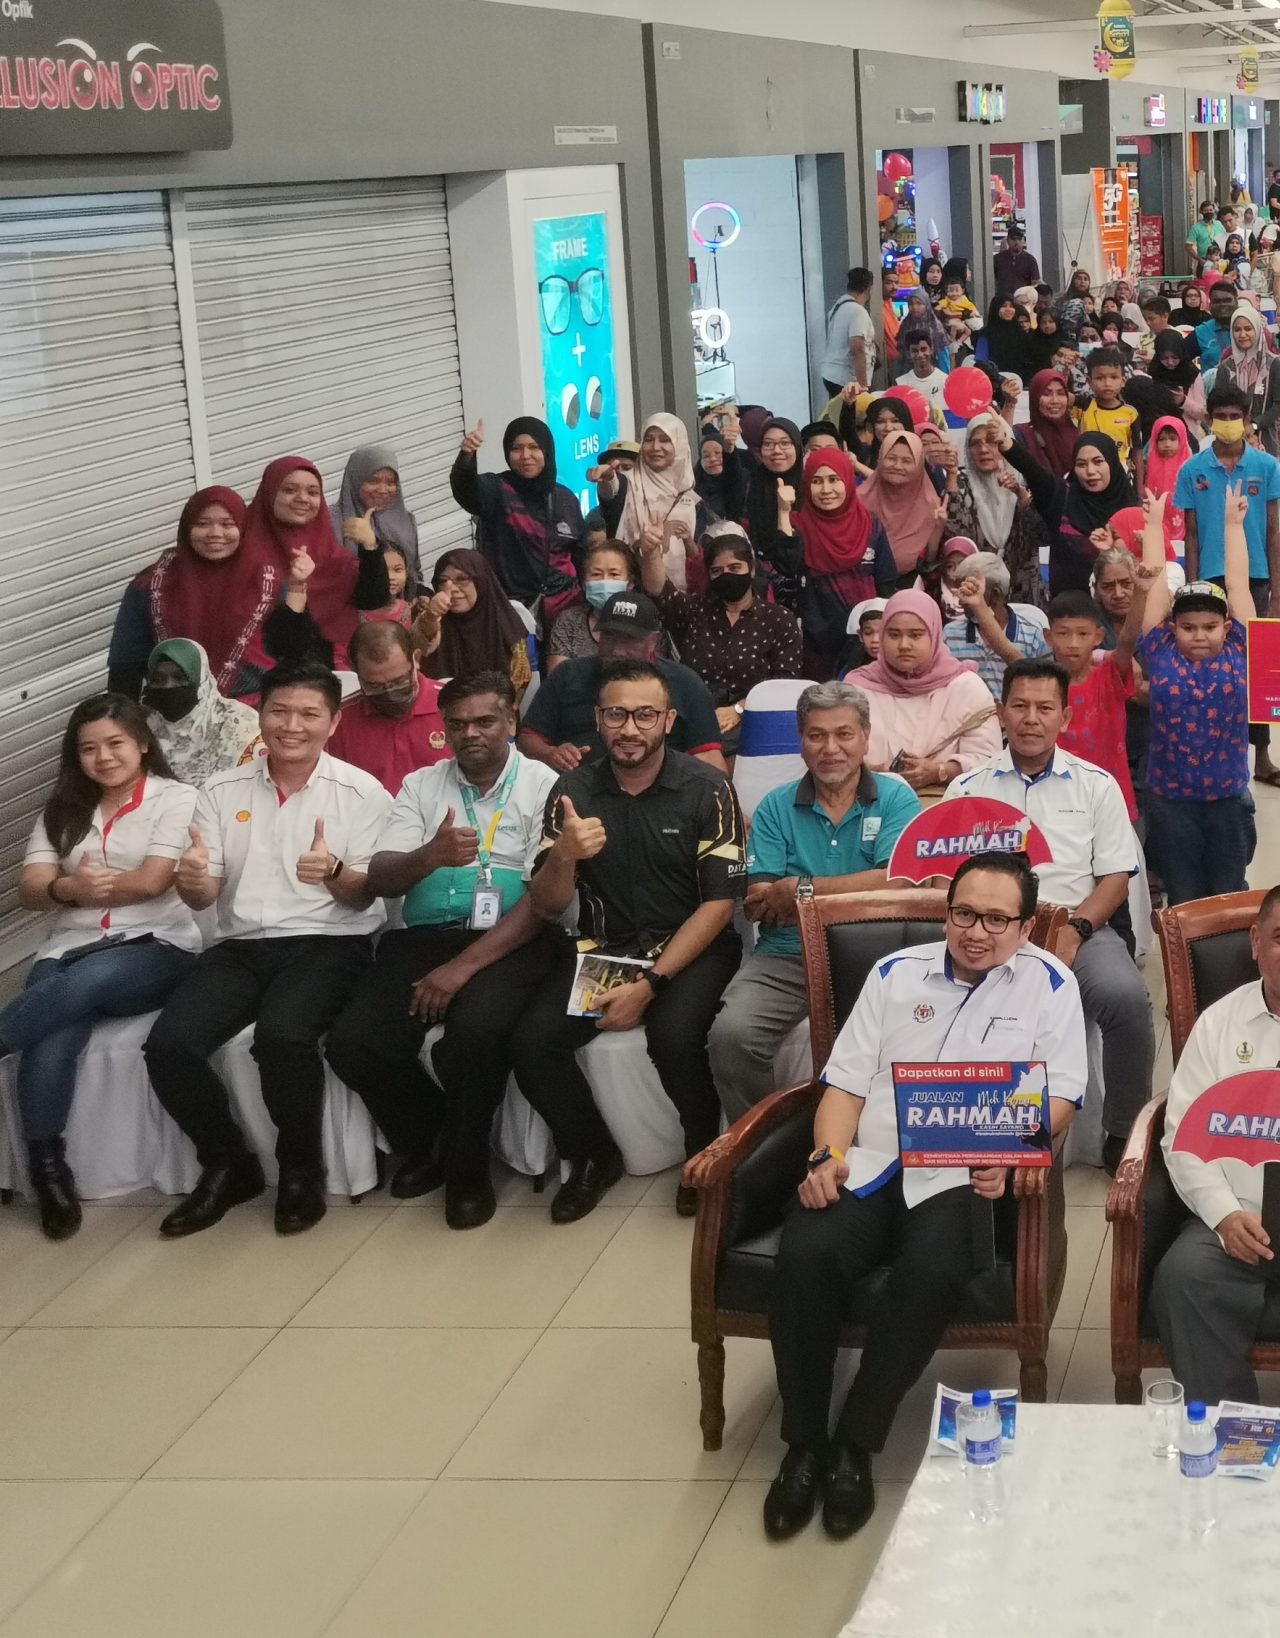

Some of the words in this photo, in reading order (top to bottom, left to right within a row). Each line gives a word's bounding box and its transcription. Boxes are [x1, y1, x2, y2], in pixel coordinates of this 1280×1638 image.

[0, 56, 124, 110] LUSION
[130, 61, 221, 110] OPTIC
[553, 237, 589, 261] FRAME
[574, 433, 600, 461] LENS
[916, 831, 1019, 857] RAHMAH
[898, 1067, 961, 1080] Dapatkan
[964, 1067, 976, 1078] di
[978, 1067, 1004, 1078] sini!
[908, 1091, 964, 1104] JUALAN
[907, 1106, 1037, 1127] RAHMAH
